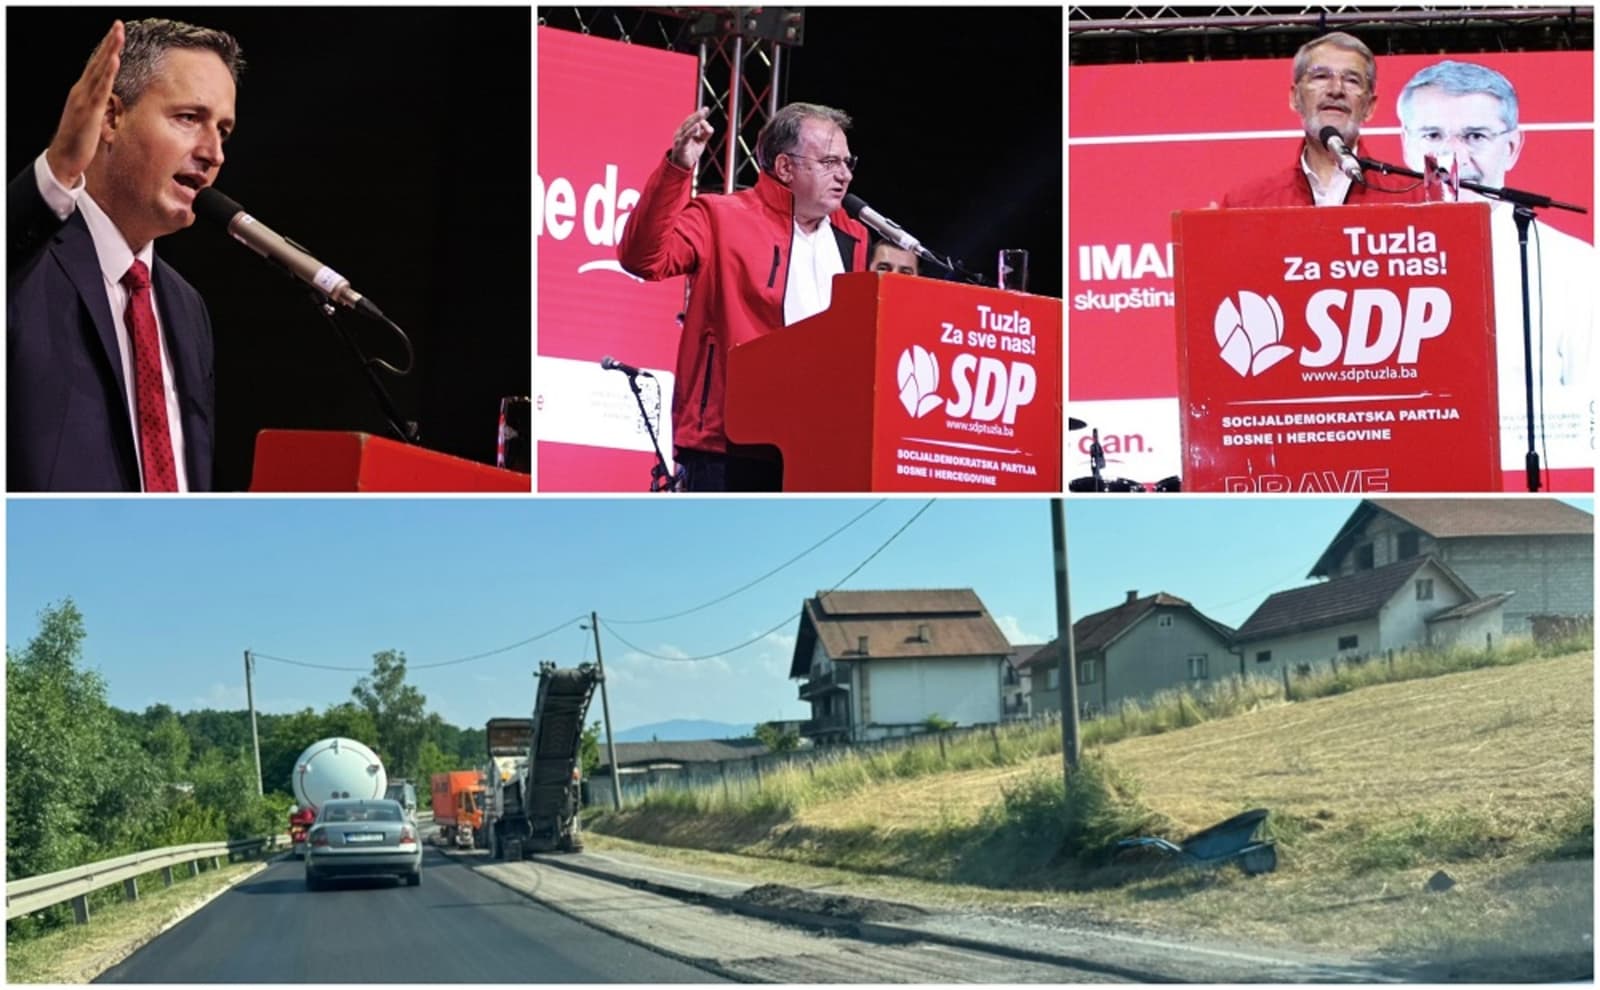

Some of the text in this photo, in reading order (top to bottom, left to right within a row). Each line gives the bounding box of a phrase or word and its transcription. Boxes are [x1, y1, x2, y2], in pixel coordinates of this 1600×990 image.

[1343, 226, 1437, 255] Tuzla
[1284, 252, 1447, 281] Za sve nas!
[977, 305, 1031, 335] Tuzla
[1299, 287, 1452, 367] SDP
[941, 323, 1036, 355] Za sve nas!
[945, 353, 1037, 425] SDP
[1301, 367, 1417, 382] www.sdptuzla.ba
[1222, 408, 1460, 428] SOCIJALDEMOKRATSKA PARTIJA
[1223, 428, 1392, 446] BOSNE I HERCEGOVINE
[897, 449, 1037, 475] SOCIJALDEMOKRATSKA PARTIJA
[897, 464, 997, 485] BOSNE I HERCEGOVINE
